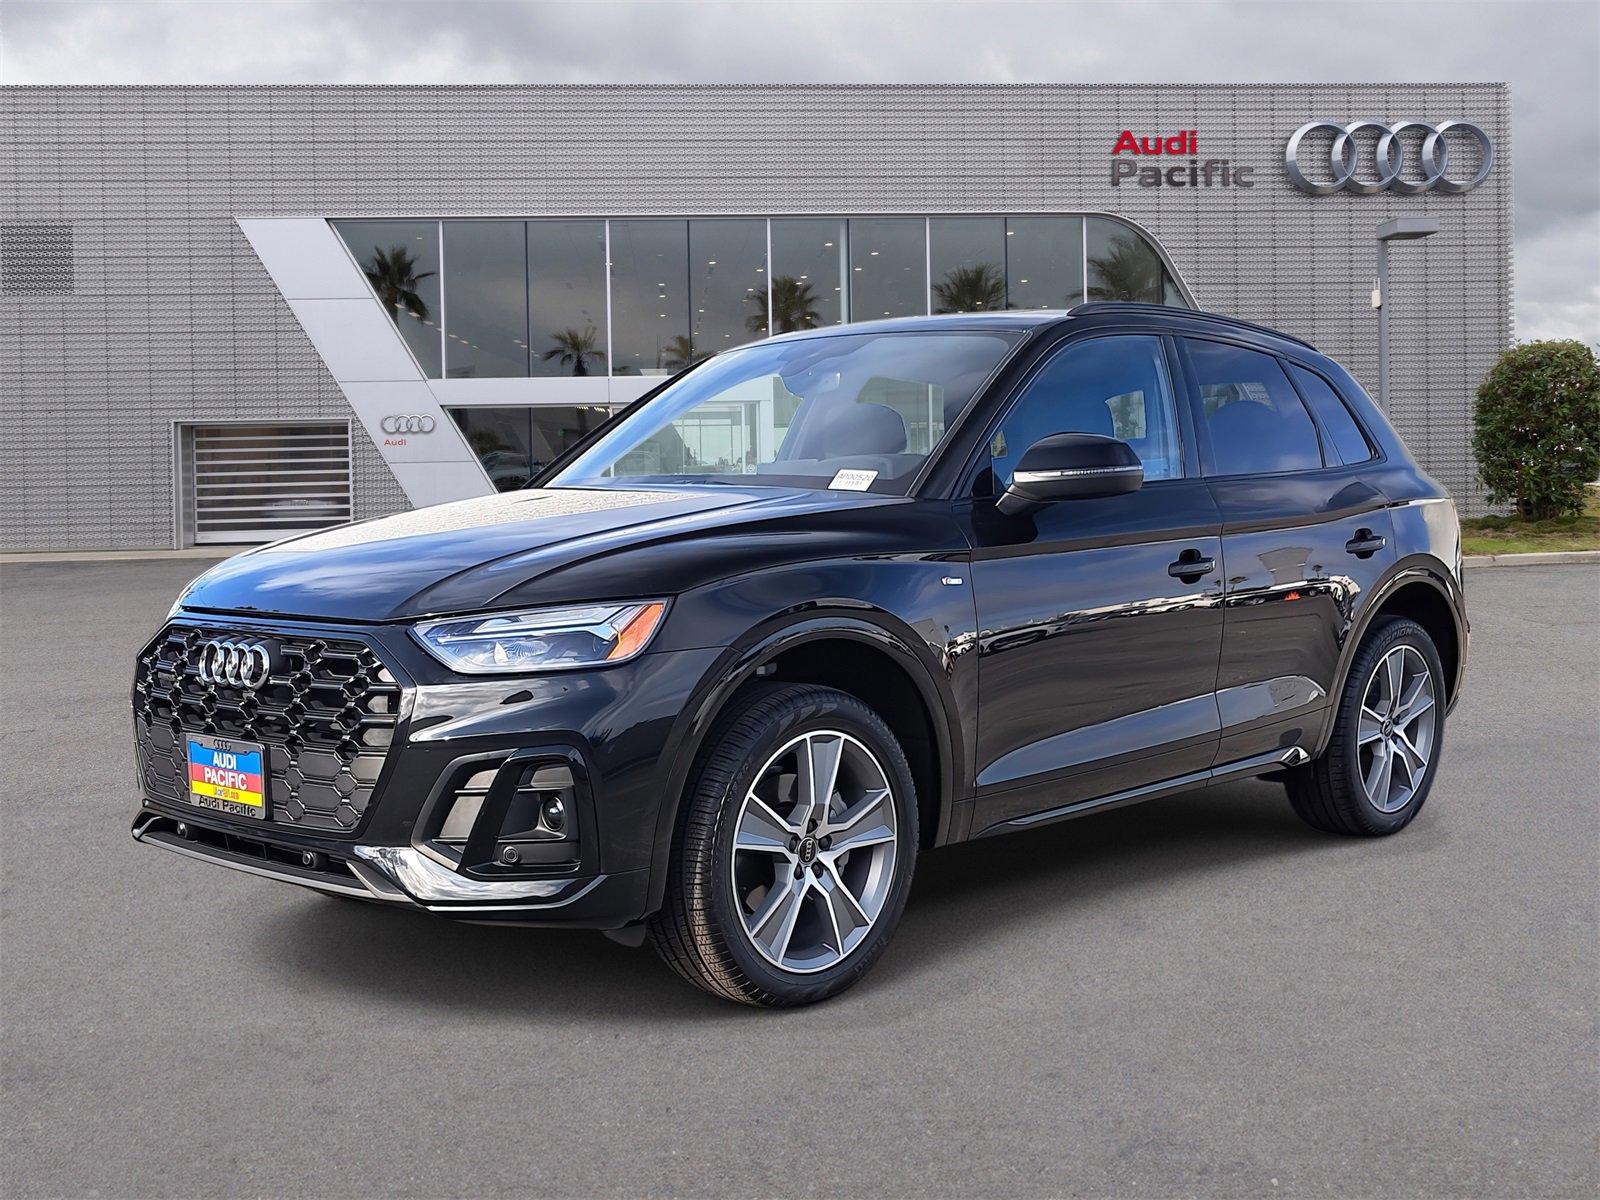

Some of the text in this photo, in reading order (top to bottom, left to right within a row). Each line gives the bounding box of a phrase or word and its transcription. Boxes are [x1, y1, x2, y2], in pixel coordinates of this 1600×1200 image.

[1111, 130, 1198, 155] Audi
[1111, 158, 1255, 187] Pacific
[212, 751, 237, 770] AUDI
[204, 767, 247, 790] PACIFIC
[199, 795, 256, 817] Audi Pacific
